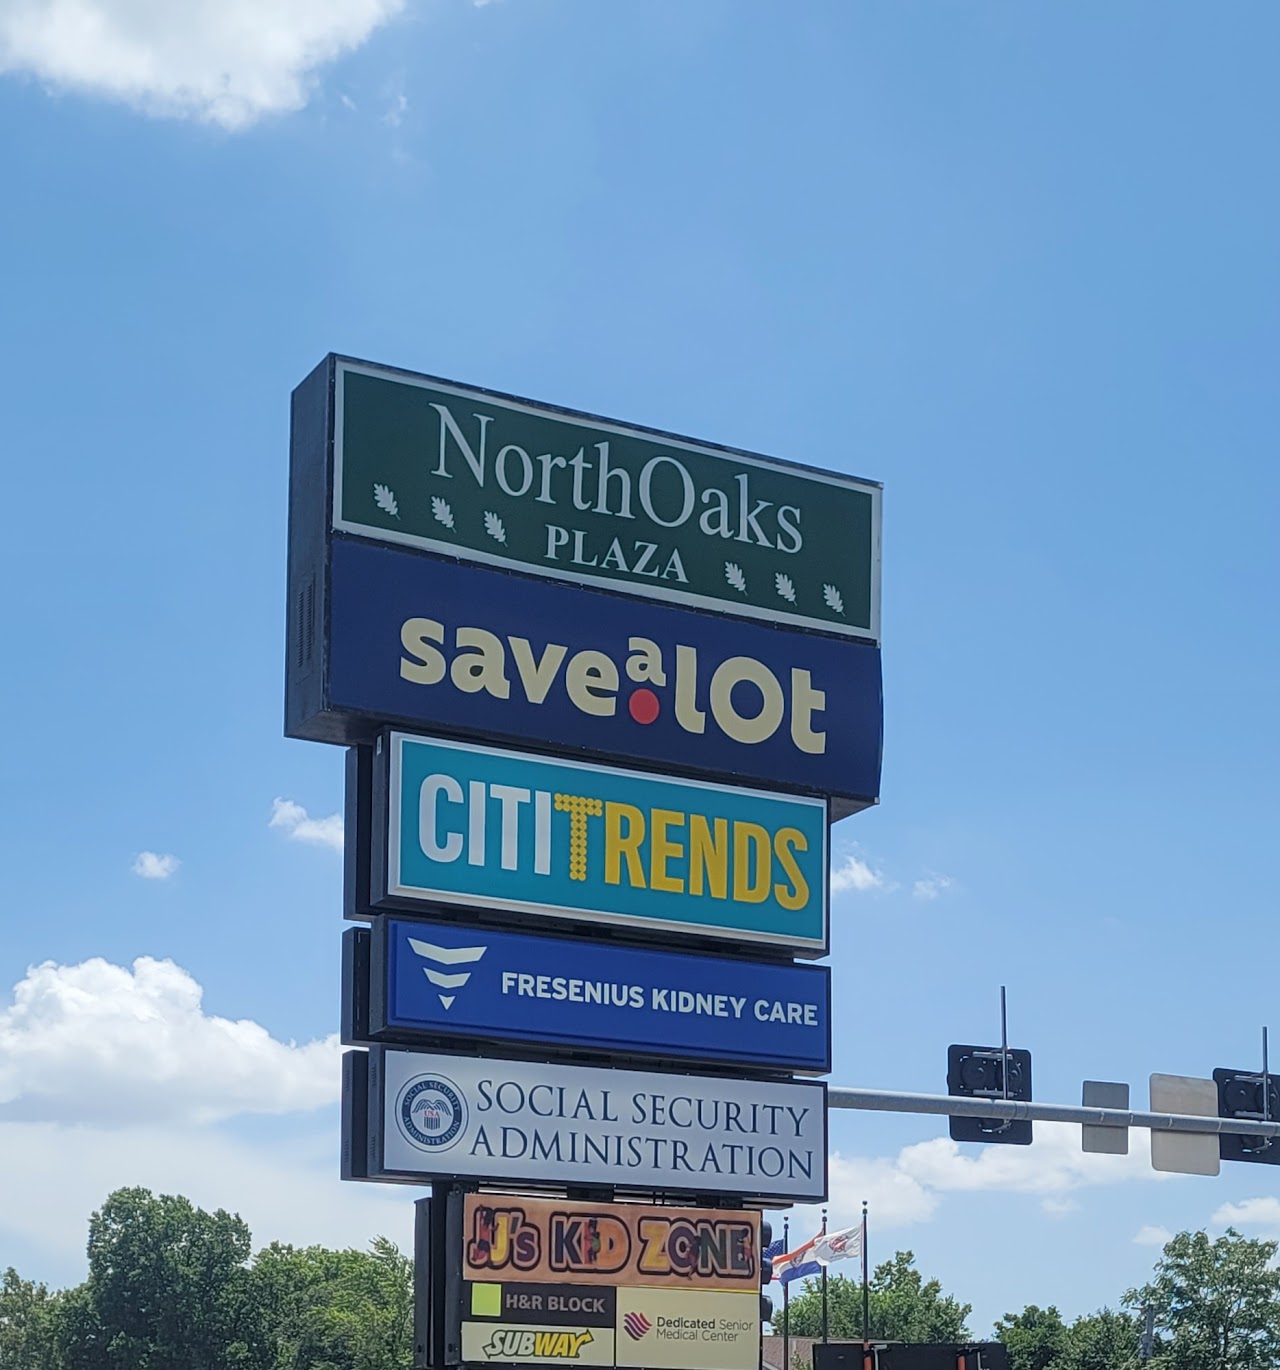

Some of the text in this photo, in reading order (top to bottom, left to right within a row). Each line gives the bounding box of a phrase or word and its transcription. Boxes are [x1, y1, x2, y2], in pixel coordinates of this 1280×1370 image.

[429, 402, 804, 554] NorthOaks
[544, 524, 690, 584] PLAZA
[502, 971, 819, 1027] FRESENIUS KIDNEY CARE
[404, 1081, 461, 1111] SOCIAL SECURITY
[476, 1079, 811, 1138] SOCIAL SECURITY
[468, 1124, 815, 1181] ADMINISTRATION
[552, 1213, 630, 1272] KID
[639, 1217, 754, 1278] ZONE
[506, 1293, 606, 1314] H&R BLOCK
[656, 1316, 753, 1331] Dedicated Senior
[483, 1329, 594, 1359] SUBWAY
[656, 1329, 739, 1342] Medical Center
